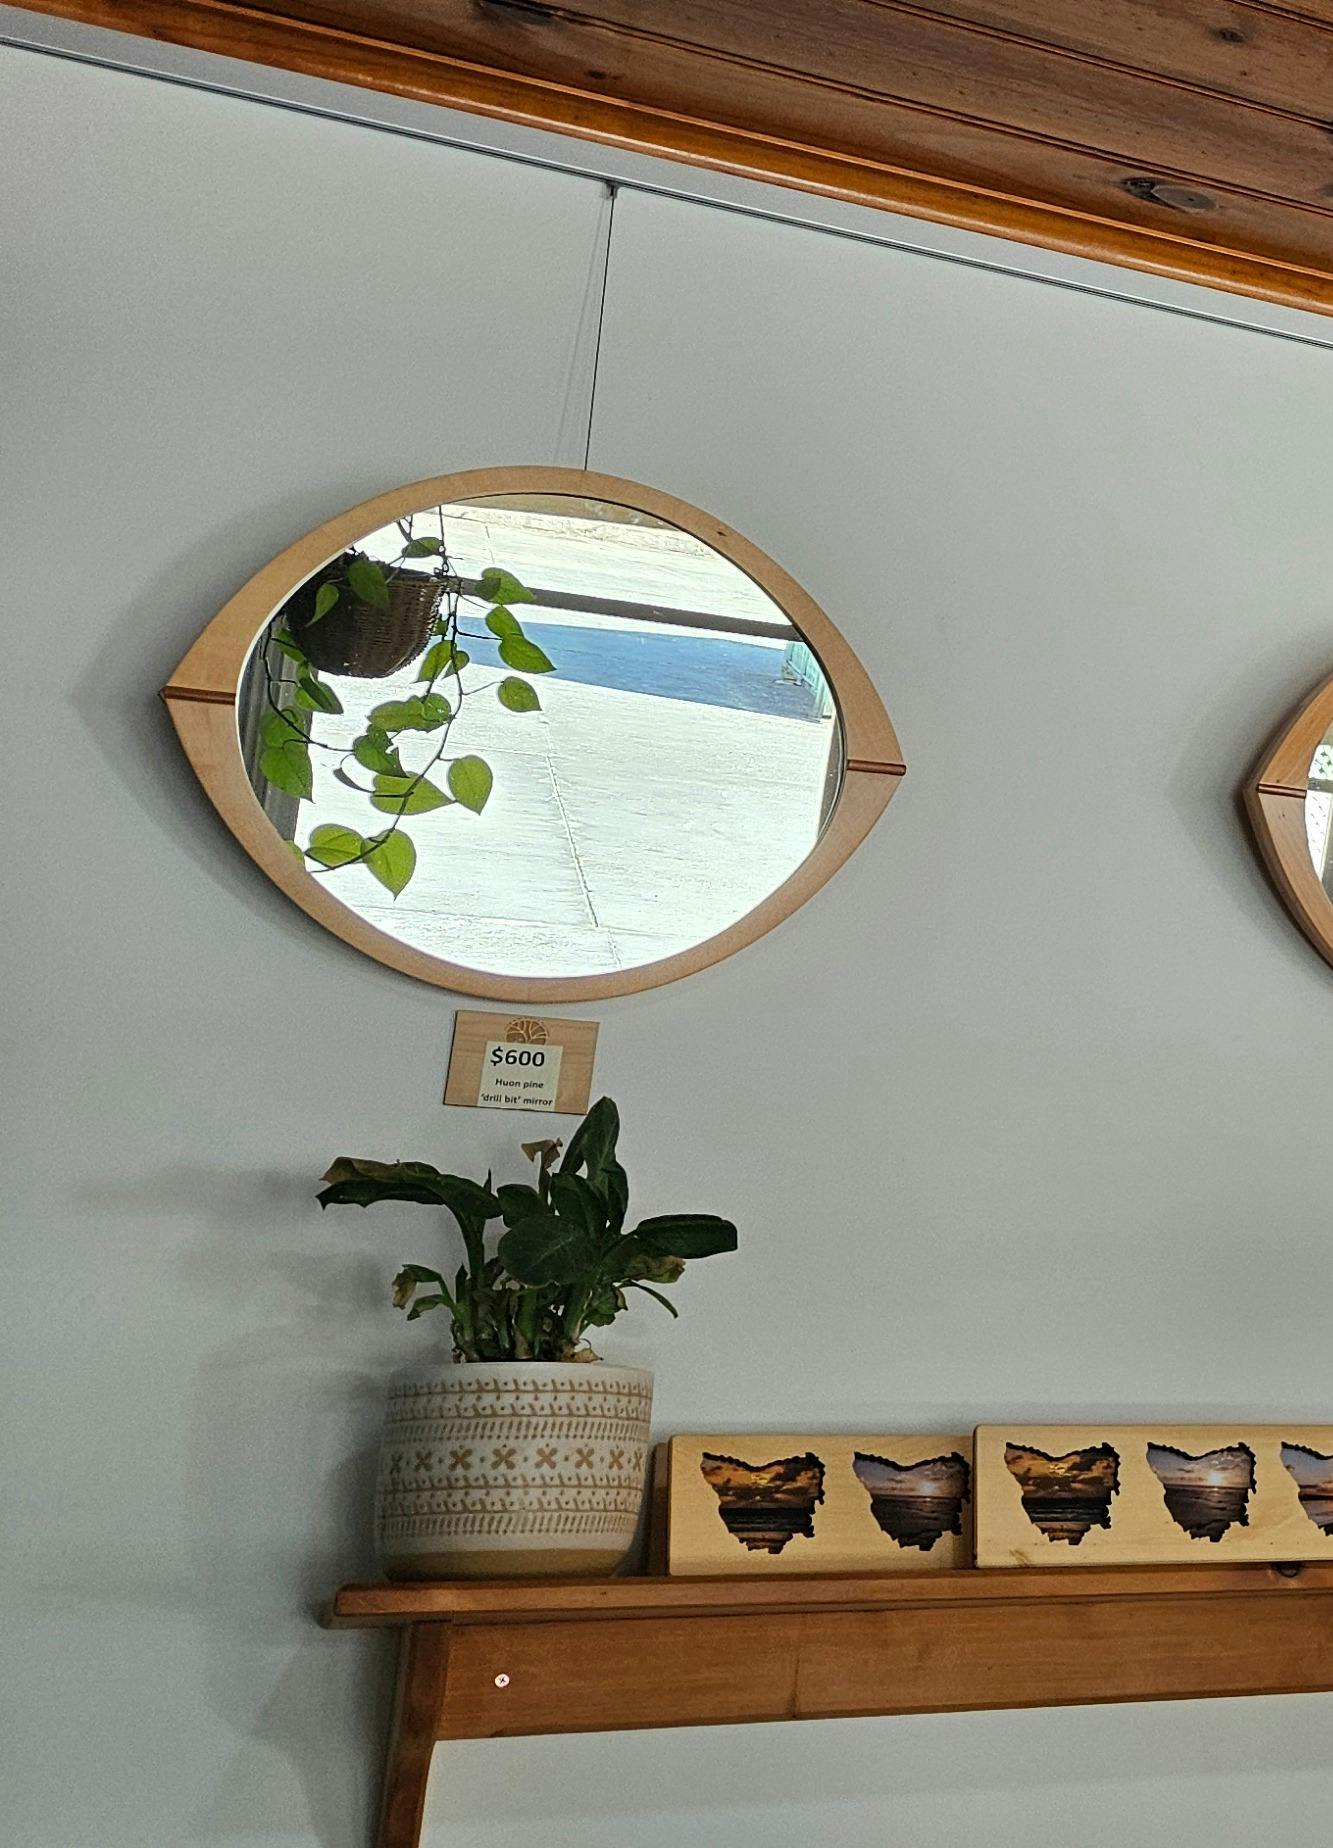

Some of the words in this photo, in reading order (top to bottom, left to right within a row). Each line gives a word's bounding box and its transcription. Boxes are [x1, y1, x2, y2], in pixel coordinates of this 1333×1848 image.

[490, 1046, 545, 1067] $600
[495, 1078, 521, 1088] Huon
[523, 1080, 544, 1089] pine
[523, 1097, 553, 1106] mirror
